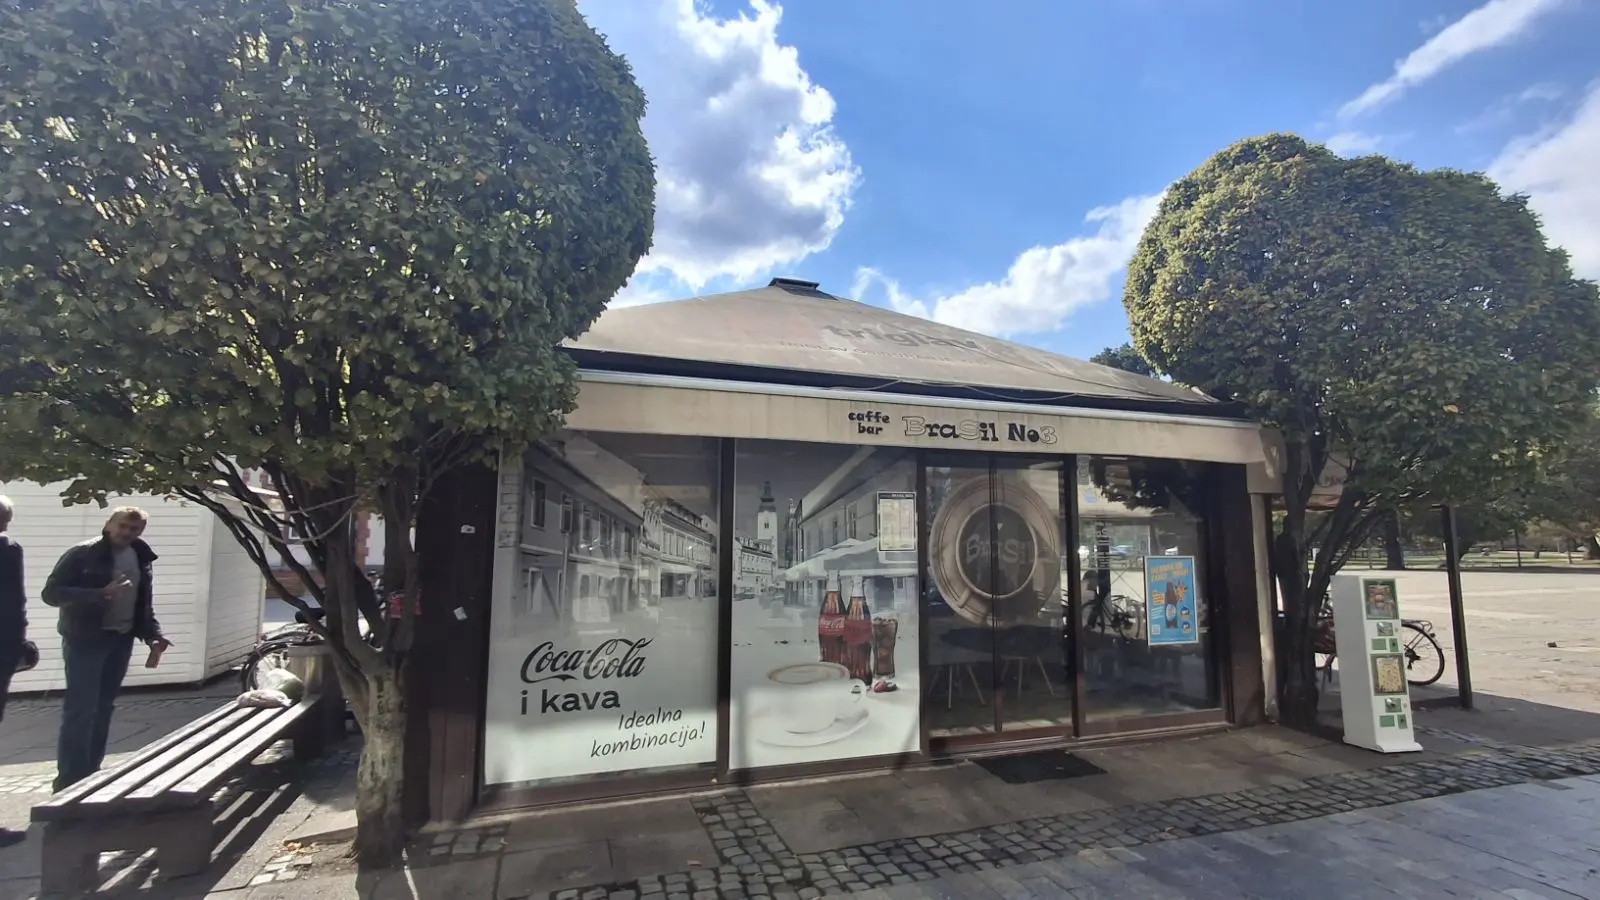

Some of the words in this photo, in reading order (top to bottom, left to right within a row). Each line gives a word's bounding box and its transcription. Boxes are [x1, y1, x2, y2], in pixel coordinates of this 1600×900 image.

[848, 410, 890, 424] caffe
[858, 423, 883, 435] bar
[520, 637, 655, 684] Coca-Cola
[520, 690, 528, 715] i
[541, 689, 620, 714] kava
[618, 706, 682, 730] Idealna
[591, 721, 705, 758] kombinacija!
